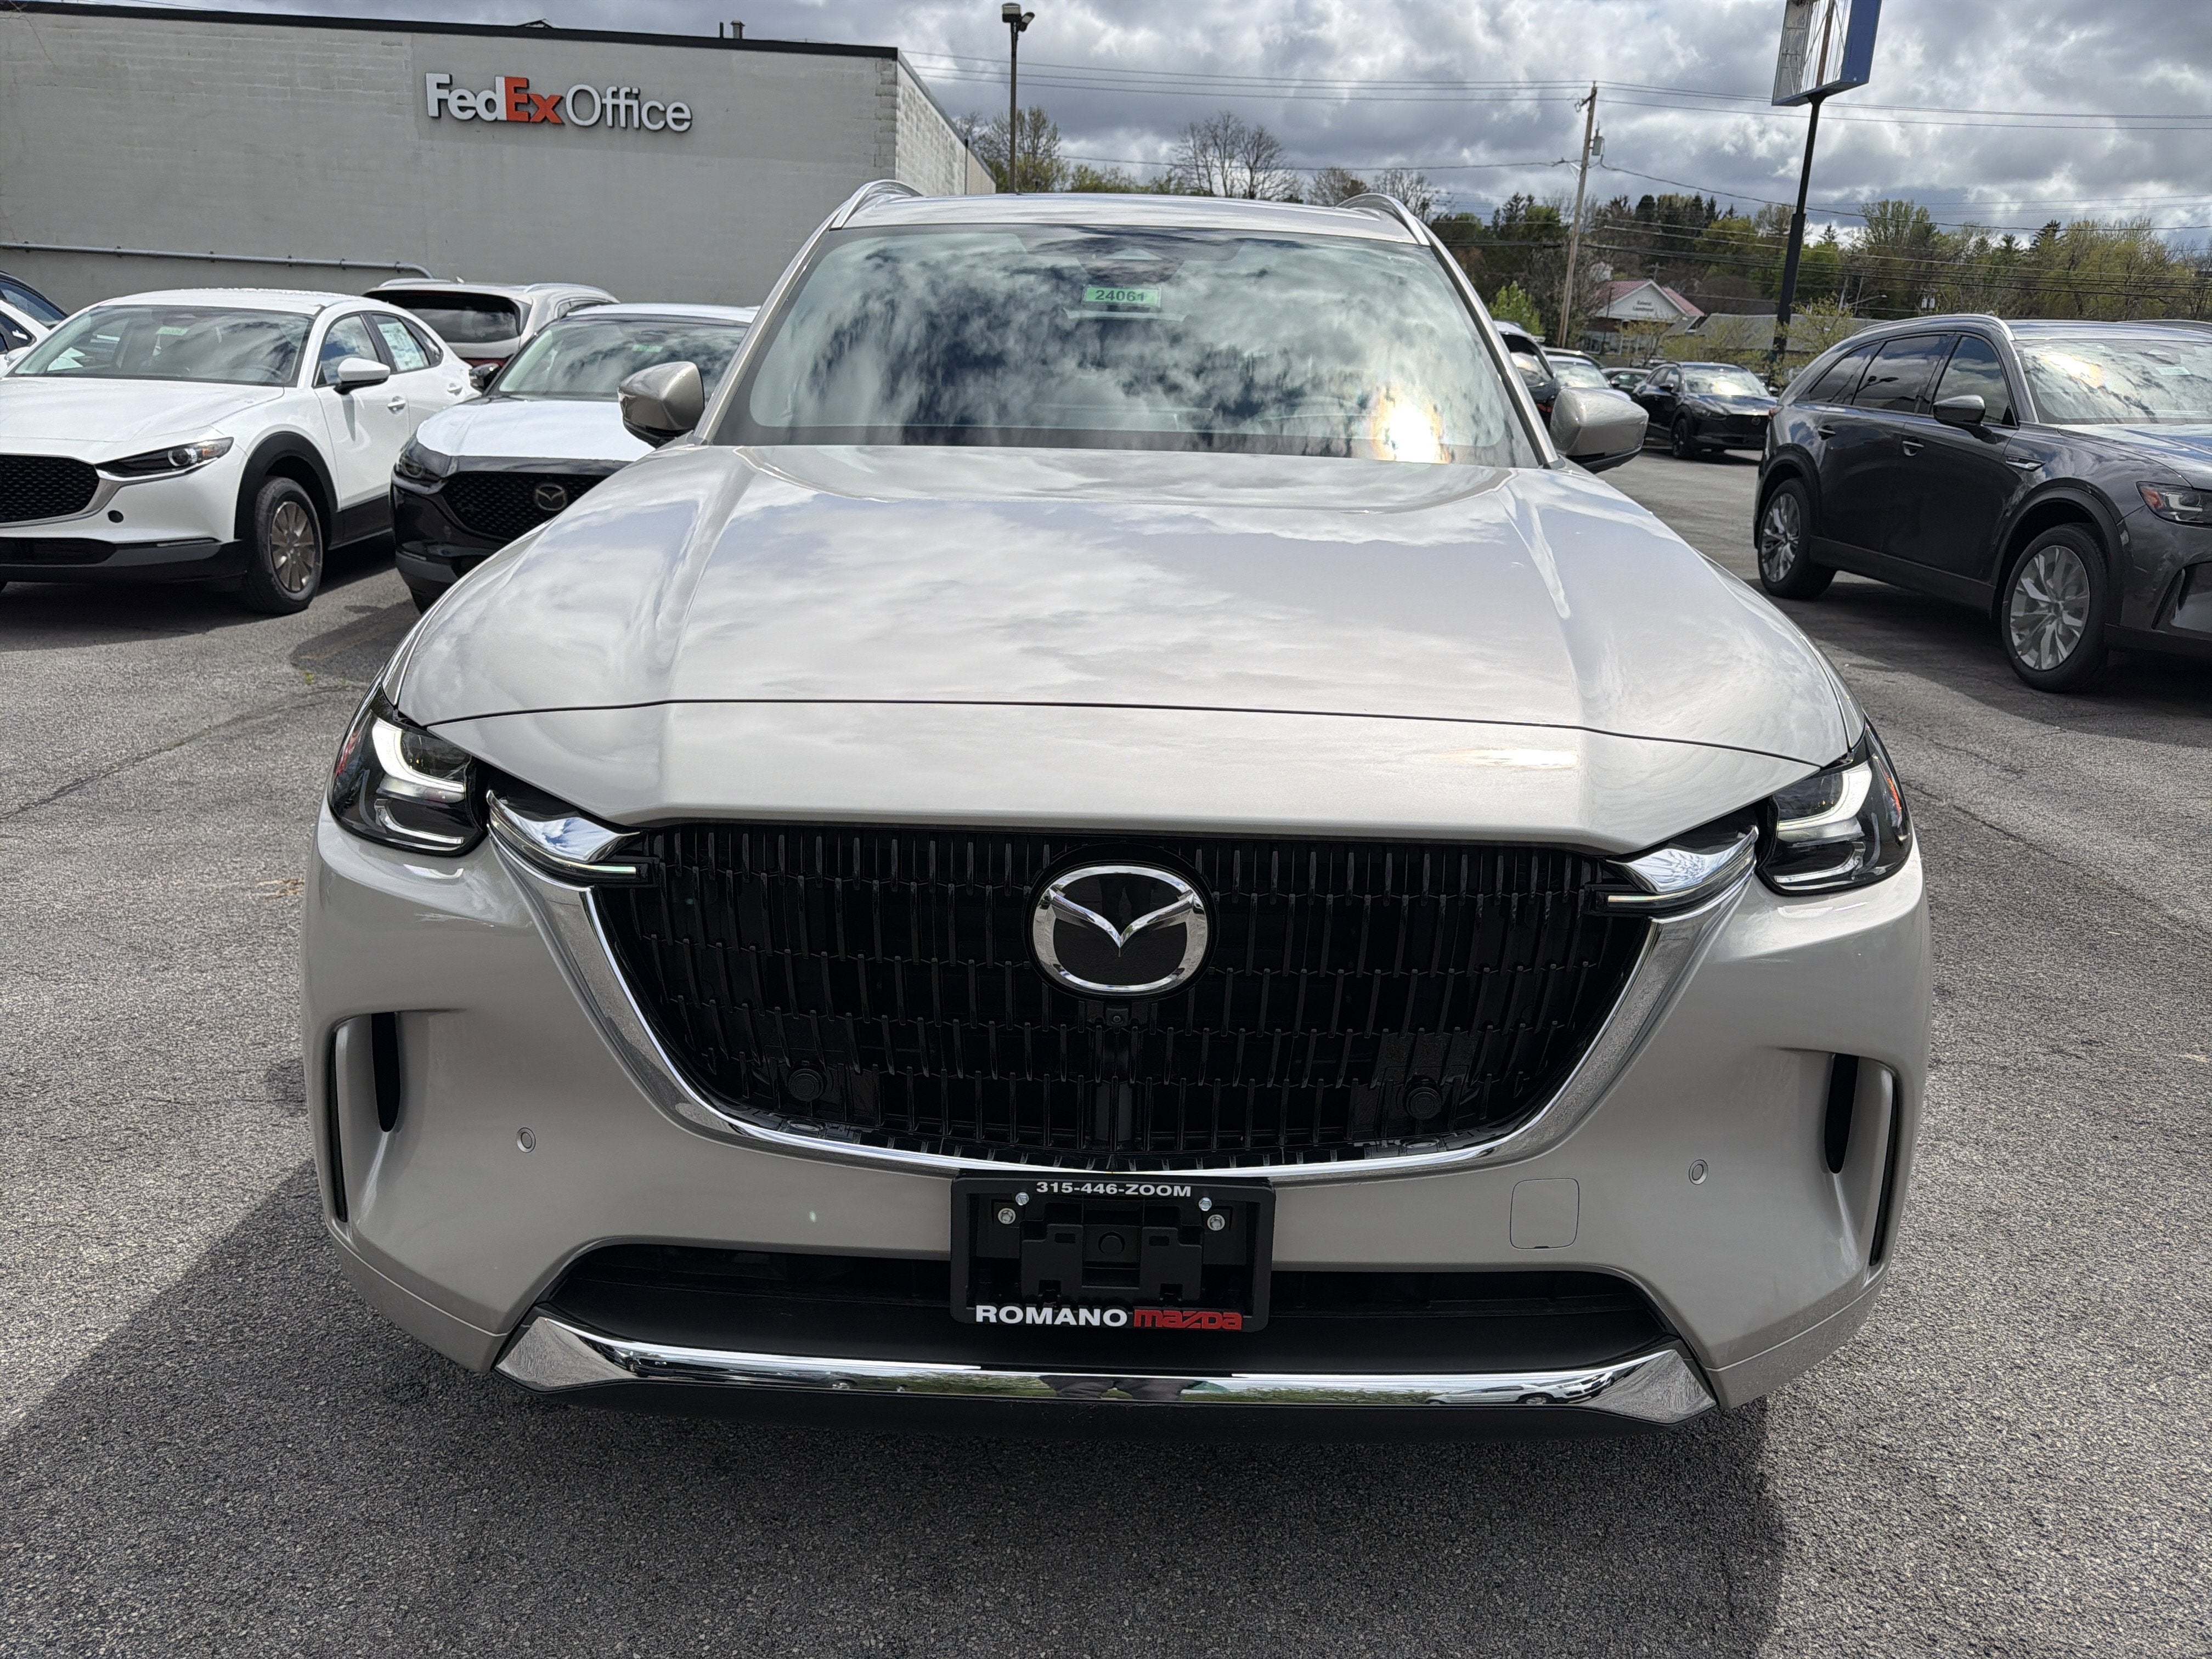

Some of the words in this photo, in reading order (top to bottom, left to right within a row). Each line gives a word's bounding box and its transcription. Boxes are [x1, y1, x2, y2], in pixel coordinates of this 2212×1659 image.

[425, 72, 565, 125] FedEx
[566, 84, 692, 132] Office
[1095, 289, 1145, 302] 24061
[1036, 1181, 1192, 1198] 315-446-ZOOM
[975, 1304, 1127, 1327] ROMANO
